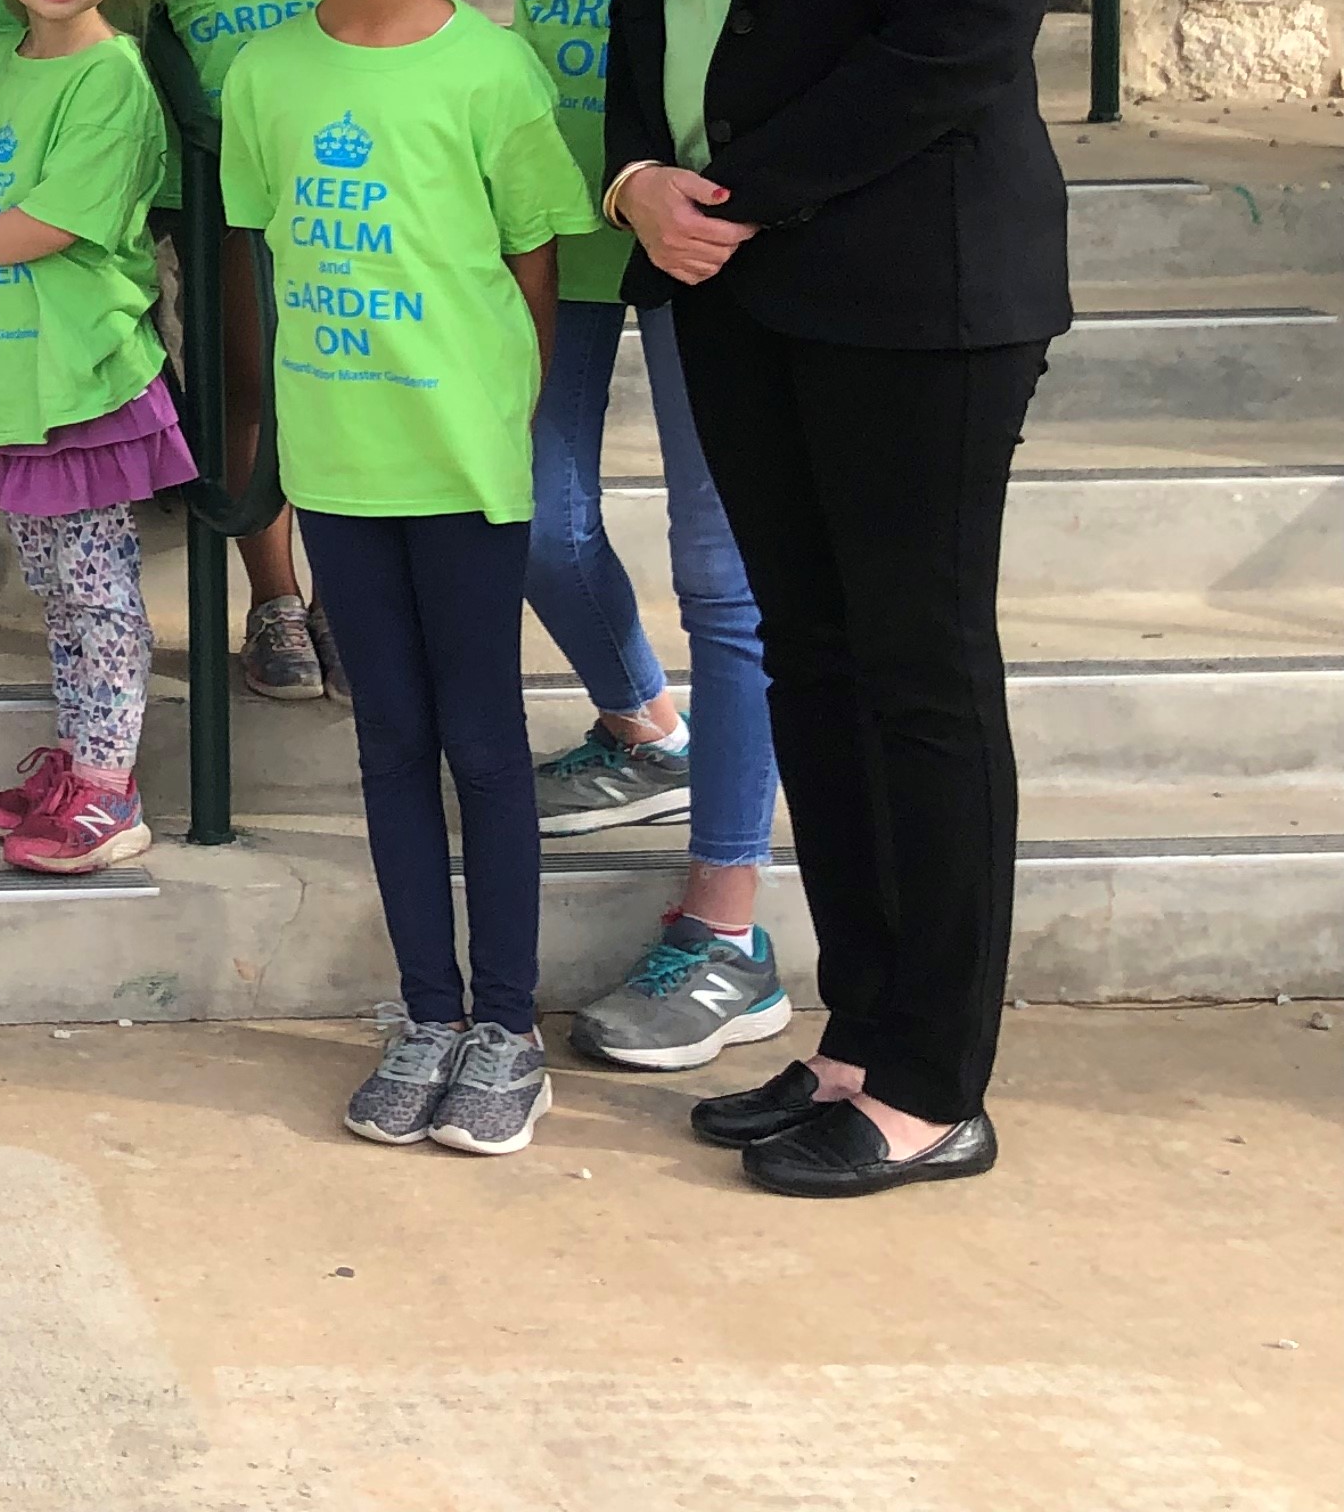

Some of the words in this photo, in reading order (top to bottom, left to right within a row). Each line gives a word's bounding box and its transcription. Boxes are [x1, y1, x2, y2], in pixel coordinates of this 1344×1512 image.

[294, 175, 388, 212] KEEP
[290, 216, 393, 254] CALM
[318, 258, 351, 276] and
[283, 279, 424, 321] GARDEN
[314, 325, 371, 356] ON
